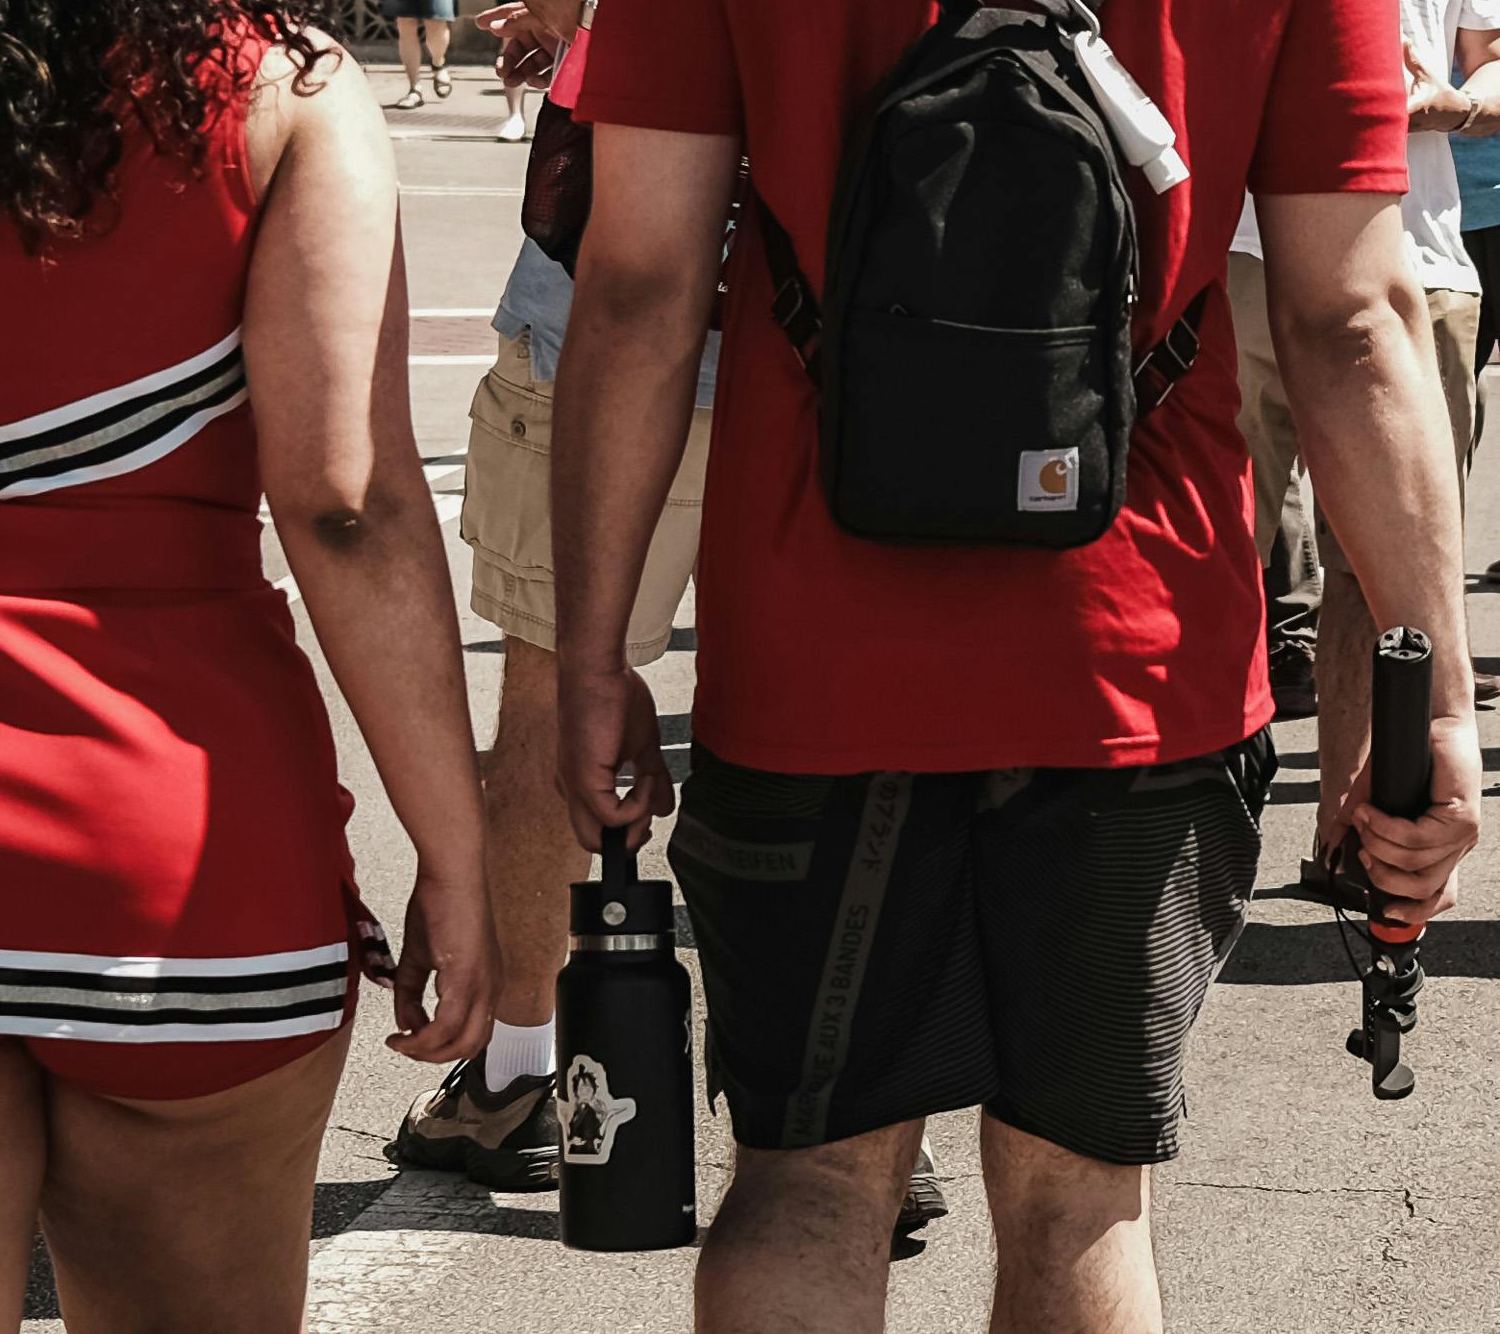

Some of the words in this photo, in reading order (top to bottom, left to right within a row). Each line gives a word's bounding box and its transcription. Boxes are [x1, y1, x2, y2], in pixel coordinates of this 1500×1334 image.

[831, 904, 870, 991] BANDES
[825, 994, 847, 1006] 3
[816, 1012, 843, 1051] AUX
